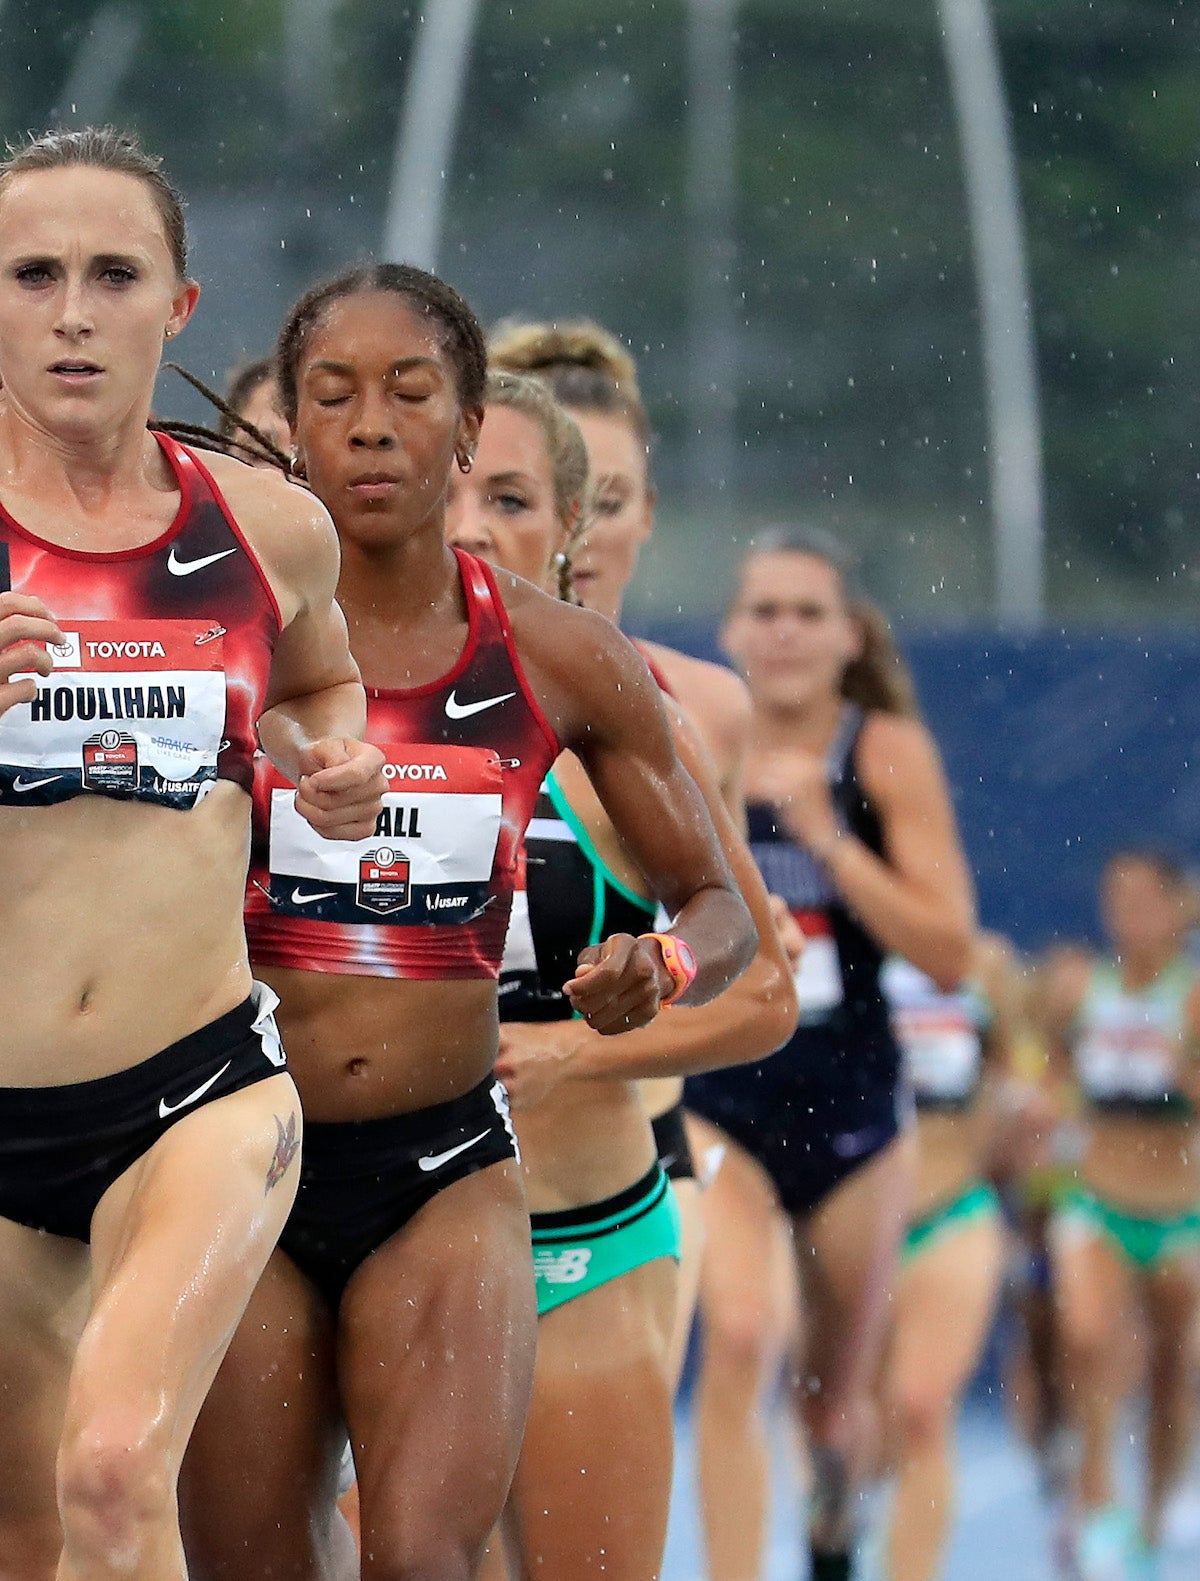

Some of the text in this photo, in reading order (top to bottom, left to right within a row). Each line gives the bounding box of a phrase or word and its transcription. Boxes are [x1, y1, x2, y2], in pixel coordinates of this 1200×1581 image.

[86, 641, 166, 658] TOYOTA
[31, 685, 186, 722] HOULIHAN
[381, 764, 448, 780] OYOTA
[168, 782, 201, 793] USATF
[373, 806, 422, 838] ALL
[440, 896, 469, 909] USATF
